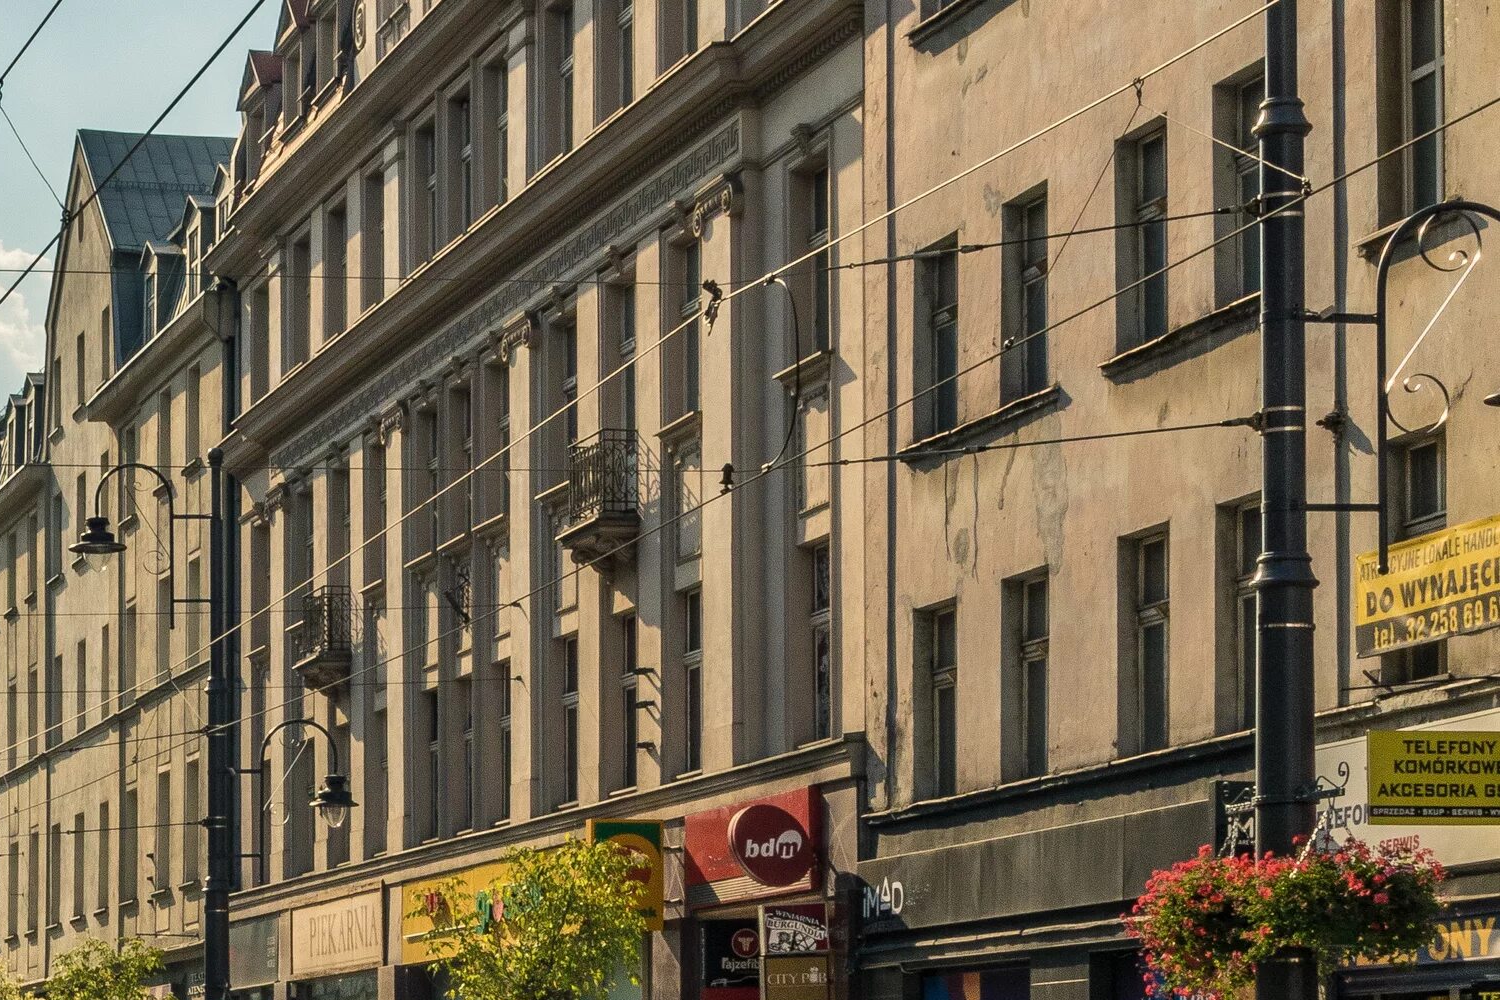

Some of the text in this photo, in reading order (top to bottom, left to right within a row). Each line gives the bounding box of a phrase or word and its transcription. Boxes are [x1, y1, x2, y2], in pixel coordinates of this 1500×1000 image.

[1423, 536, 1460, 565] LOKALE
[1366, 587, 1394, 617] DO
[1373, 621, 1401, 650] tel.
[1406, 615, 1426, 641] 32
[1430, 606, 1458, 637] 258
[1463, 600, 1484, 629] 69
[1402, 740, 1497, 755] TELEFONY
[1377, 783, 1478, 797] AKCESORIA
[1379, 834, 1420, 853] SERWIS
[308, 904, 379, 958] PIEKARNIA
[767, 972, 798, 985] CITY
